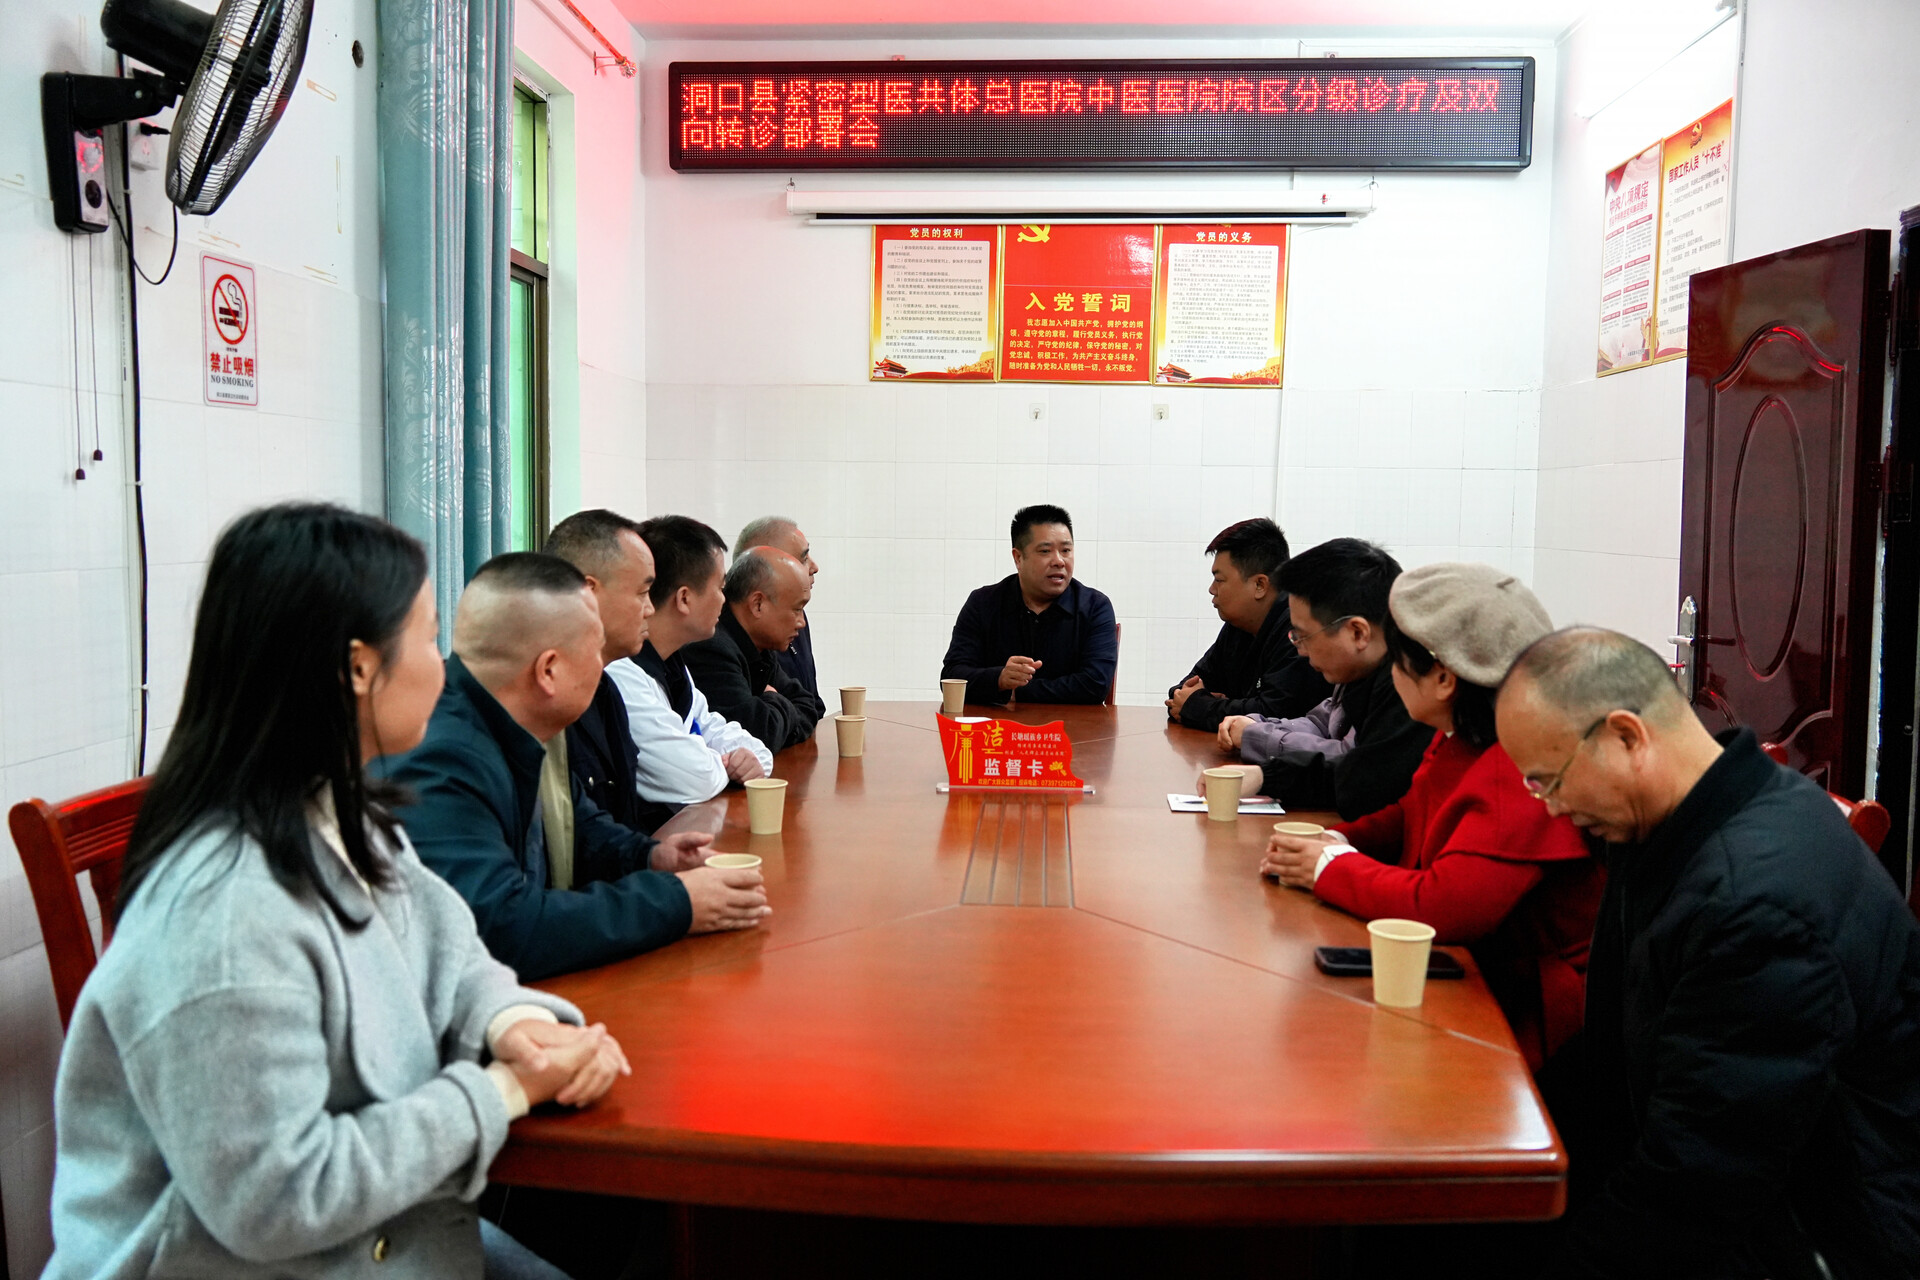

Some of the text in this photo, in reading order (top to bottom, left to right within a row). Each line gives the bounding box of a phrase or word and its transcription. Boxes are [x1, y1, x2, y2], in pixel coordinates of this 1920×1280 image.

[681, 77, 1500, 115] 洞口县紧密型医共体总医院中医医院院区分级诊疗及双
[681, 115, 881, 150] 向转诊部署会
[909, 227, 964, 238] 党员的权利
[1195, 231, 1252, 243] 党员的义务
[1025, 292, 1131, 313] 入党誓词
[210, 352, 254, 378] 禁止吸烟
[210, 374, 254, 388] NO SMOKING
[984, 759, 1044, 777] 监督卡
